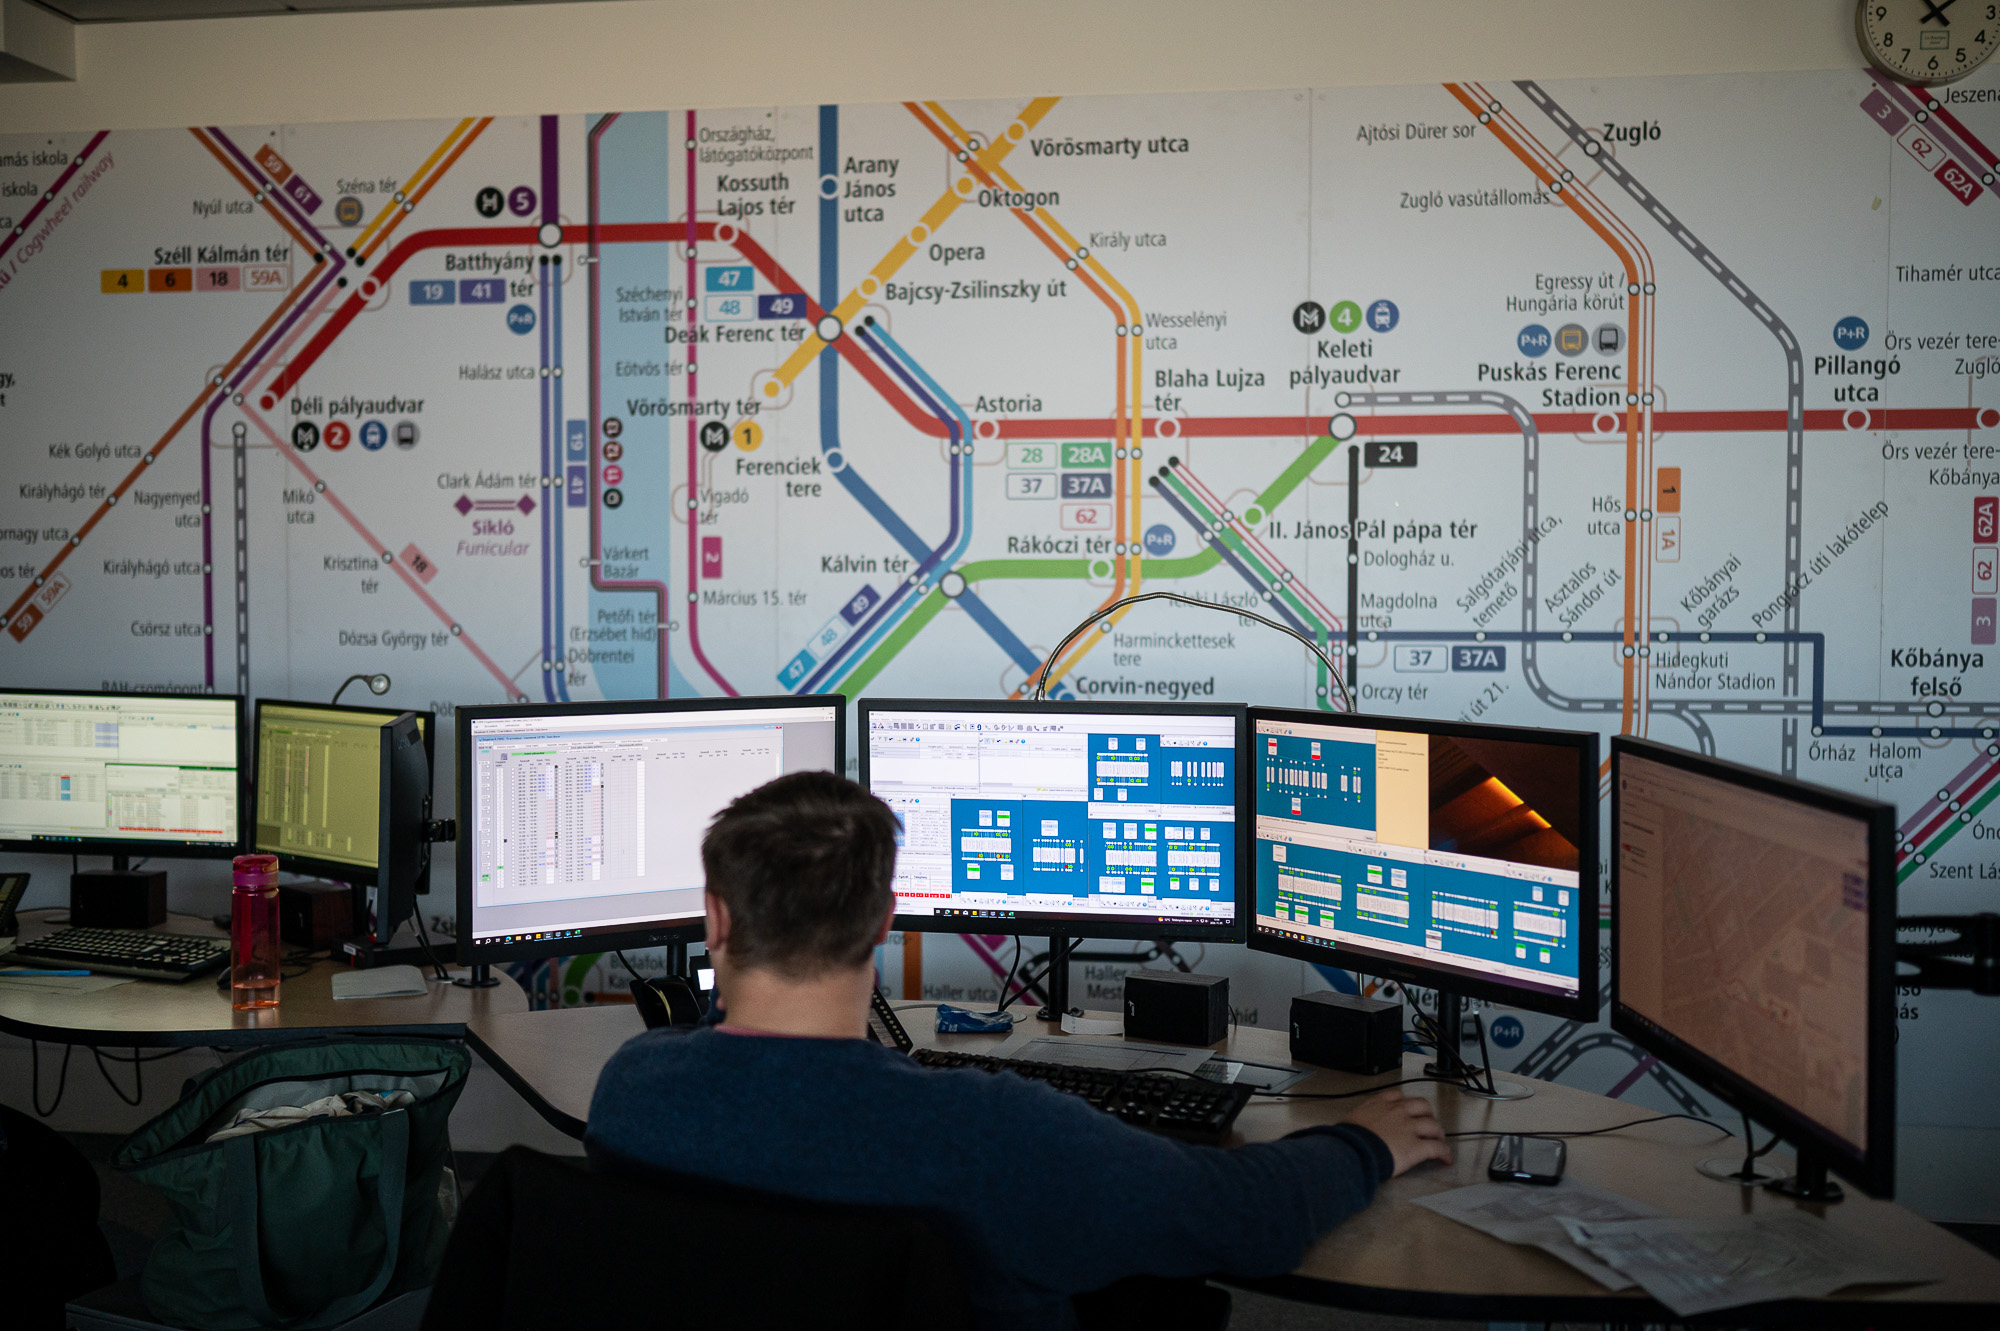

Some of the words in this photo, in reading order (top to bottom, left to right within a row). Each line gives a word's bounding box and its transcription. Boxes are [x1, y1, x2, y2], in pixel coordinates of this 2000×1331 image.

[1876, 7, 1887, 20] 9
[1986, 5, 1996, 20] 3
[1883, 33, 1893, 47] 8
[1974, 30, 1986, 44] 4
[1901, 48, 1911, 63] 7
[1928, 56, 1938, 70] 6
[1955, 48, 1966, 62] 5
[1357, 123, 1400, 145] Ajtósi
[1406, 122, 1447, 140] Dürer
[1453, 125, 1476, 139] sor
[1603, 121, 1661, 146] Zugló
[1031, 139, 1143, 160] Vörösmarty
[1147, 137, 1190, 154] utca
[845, 157, 899, 177] Arany
[718, 173, 789, 192] Kossuth
[845, 182, 896, 199] János
[1944, 168, 1974, 199] 62A
[17, 197, 73, 264] Cogwheel
[72, 152, 115, 203] railway
[717, 198, 764, 220] Lajos
[769, 197, 796, 215] tér
[978, 189, 1060, 211] Oktogon
[1401, 190, 1443, 212] Zugló
[1448, 188, 1550, 208] vasútállomás
[845, 206, 884, 223] utca
[1090, 232, 1130, 251] Király
[1134, 233, 1167, 248] utca
[154, 247, 191, 265] Széll
[197, 246, 259, 264] Kálmán
[265, 245, 289, 262] tér
[445, 253, 535, 274] Batthyány
[929, 244, 985, 265] Opera
[510, 279, 535, 298] tér
[718, 271, 741, 288] 47
[1535, 274, 1593, 292] Egressy
[1598, 273, 1615, 289] út
[616, 286, 683, 304] Széchenyi
[886, 282, 1041, 305] Bajcsy-Zsilinszky
[1046, 279, 1067, 298] út
[719, 300, 741, 316] 48
[770, 298, 793, 316] 49
[1507, 296, 1577, 316] Hungária
[1584, 293, 1625, 311] körút
[1146, 311, 1227, 331] Wesselényi
[1338, 308, 1353, 326] 4
[665, 326, 709, 343] Deák
[716, 325, 775, 343] Ferenc
[780, 324, 806, 341] tér
[1521, 333, 1548, 348] P+R
[1837, 327, 1865, 340] P+R
[1885, 331, 1912, 351] Örs
[1918, 332, 1959, 349] vezér
[1146, 336, 1178, 351] utca
[1318, 339, 1373, 358] Keleti
[1478, 363, 1547, 382] Puskás
[1555, 363, 1621, 381] Ferenc
[1814, 355, 1901, 379] Pillangó
[1955, 358, 2000, 379] Zugló
[1156, 370, 1209, 388] Blaha
[1217, 370, 1266, 391] Lujza
[1289, 365, 1400, 389] pályaudvar
[1155, 393, 1181, 412] tér
[1542, 388, 1620, 407] Stadion
[1834, 385, 1879, 402] utca
[291, 397, 323, 415] Déli
[329, 396, 424, 419] pályaudvar
[627, 398, 730, 420] Vörösmarty
[736, 397, 762, 415] tér
[976, 396, 1043, 413] Astoria
[331, 428, 343, 444] 2
[743, 428, 753, 444] 1
[49, 444, 69, 458] Kék
[75, 443, 110, 461] Golyó
[115, 446, 141, 458] utca
[1020, 447, 1043, 464] 28
[1068, 446, 1106, 464] 28A
[1378, 446, 1404, 463] 24
[1882, 441, 1909, 460] Örs
[1915, 442, 1957, 460] vezér
[737, 458, 821, 477] Ferenciek
[438, 473, 470, 488] Clark
[475, 471, 515, 488] Ádám
[519, 473, 536, 488] tér
[1068, 477, 1106, 495] 37A
[1929, 468, 2000, 486] Kőbánya
[19, 484, 85, 503] Királyhágó
[89, 484, 106, 498] tér
[786, 480, 821, 497] tere
[1020, 478, 1042, 495] 37
[134, 491, 200, 506] Nagyenyed
[701, 489, 749, 506] Vigadó
[1592, 495, 1621, 512] Hős
[1075, 508, 1097, 525] 62
[1978, 503, 1993, 537] 62A
[472, 520, 514, 536] Sikló
[1269, 522, 1288, 538] II.
[1294, 521, 1350, 539] János
[1357, 520, 1387, 538] Pál
[1393, 522, 1444, 543] pápa
[1450, 520, 1478, 538] tér
[1587, 520, 1620, 535] utca
[456, 540, 531, 557] Funicular
[1008, 535, 1081, 553] Rákóczi
[1086, 534, 1112, 553] tér
[103, 560, 170, 578] Királyhágó
[174, 562, 200, 576] utca
[324, 556, 378, 571] Krisztina
[822, 555, 877, 573] Kálvin
[884, 555, 909, 573] tér
[1364, 551, 1436, 569] Dologház
[1441, 554, 1454, 566] u.
[1456, 540, 1531, 613] Salgótarjáni
[1529, 515, 1563, 545] utca,
[1751, 571, 1813, 629] Pongrácz
[1810, 553, 1831, 576] úti
[1825, 500, 1889, 558] lakótelep
[1544, 561, 1597, 613] Asztalos
[1680, 553, 1742, 613] Kőbányai
[704, 590, 757, 606] Március
[763, 591, 785, 605] 15.
[788, 590, 807, 606] tér
[1361, 593, 1437, 612] Magdolna
[1472, 581, 1518, 628] temető
[1558, 583, 1605, 629] Sándor
[1603, 568, 1622, 587] út
[1698, 586, 1740, 631] garázs
[1360, 614, 1392, 628] utca
[1113, 632, 1235, 650] Harminckettesek
[1113, 652, 1141, 666] tere
[1409, 650, 1432, 667] 37
[1459, 649, 1498, 667] 37A
[1656, 652, 1729, 671] Hidegkuti
[1891, 648, 1985, 672] Kőbánya
[1076, 676, 1214, 699] Corvin-negyed
[1656, 672, 1711, 690] Nándor
[1718, 672, 1775, 690] Stadion
[1910, 676, 1962, 697] felső
[1362, 684, 1403, 702] Orczy
[1408, 684, 1428, 699] tér
[1809, 742, 1856, 761] Őrház
[1869, 742, 1922, 760] Halom
[1869, 764, 1904, 779] utca
[1930, 862, 1973, 880] Szent
[925, 984, 964, 1001] Haller
[969, 988, 998, 1001] utca
